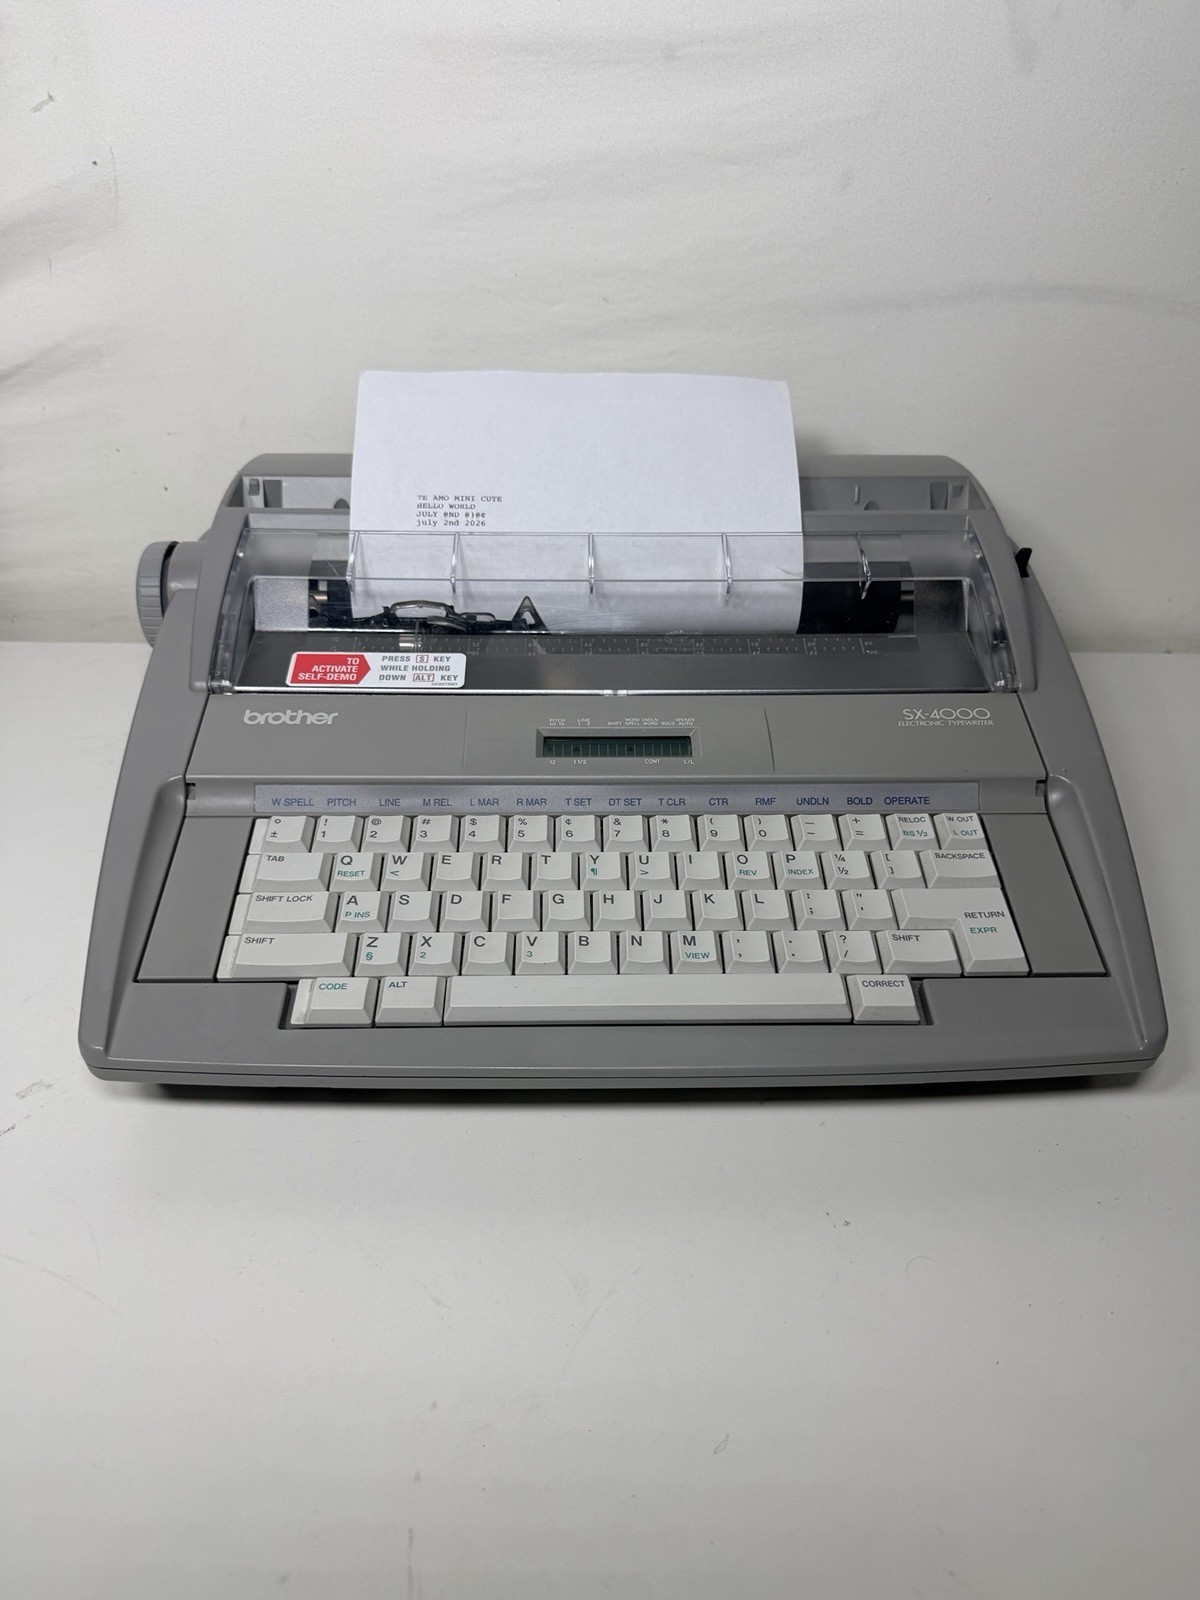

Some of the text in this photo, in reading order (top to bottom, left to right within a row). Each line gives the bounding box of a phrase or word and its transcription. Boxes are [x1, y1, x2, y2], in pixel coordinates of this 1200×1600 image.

[347, 657, 360, 665] TO
[312, 665, 358, 673] ACTIVATE
[298, 673, 357, 681] SELF-DEMO
[244, 709, 339, 725] brother
[902, 707, 991, 720] SX-4000
[272, 798, 314, 806] W SPELL
[327, 798, 357, 806] PITCH
[379, 798, 400, 806] LINE
[422, 798, 452, 806] M REL
[470, 798, 499, 806] L MAR
[516, 798, 547, 806] R MAR
[566, 798, 592, 806] T SET
[608, 798, 642, 806] DT SET
[658, 798, 686, 806] T CLR
[708, 798, 729, 806] CTR
[755, 798, 776, 806] RMF
[796, 797, 829, 806] UNDLN
[847, 797, 873, 805] BOLD
[884, 797, 930, 805] OPERATE
[371, 818, 382, 826] @
[469, 818, 477, 826] $
[518, 818, 528, 826] %
[613, 818, 622, 826] &
[468, 830, 476, 838] 4
[517, 830, 525, 838] 5
[566, 830, 573, 838] 6
[614, 830, 621, 838] 7
[662, 830, 670, 838] 8
[392, 855, 408, 865] W
[441, 855, 452, 864] E
[491, 855, 502, 865] R
[541, 855, 551, 864] T
[589, 855, 600, 864] Y
[639, 855, 649, 865] U
[785, 854, 796, 863] P
[885, 853, 891, 862] [
[935, 852, 985, 860] BACKSPACE
[340, 855, 353, 866] Q
[889, 866, 895, 875] ]
[255, 895, 285, 903] SHIFT
[346, 895, 359, 905] A
[399, 894, 410, 905] S
[450, 894, 462, 904] D
[502, 894, 512, 904] F
[552, 893, 565, 904] G
[603, 894, 614, 904] H
[653, 894, 663, 904] J
[704, 893, 715, 904] K
[754, 893, 765, 904] L
[964, 911, 1005, 919] RETURN
[969, 926, 998, 934] EXPR
[244, 937, 275, 945] SHIFT
[366, 937, 379, 947] Z
[420, 936, 433, 947] X
[473, 936, 486, 947] C
[526, 936, 538, 947] V
[578, 936, 590, 947] B
[631, 935, 643, 946] N
[683, 935, 696, 946] M
[839, 935, 847, 944] ?
[892, 934, 920, 942] SHIFT
[862, 980, 905, 988] CORRECT
